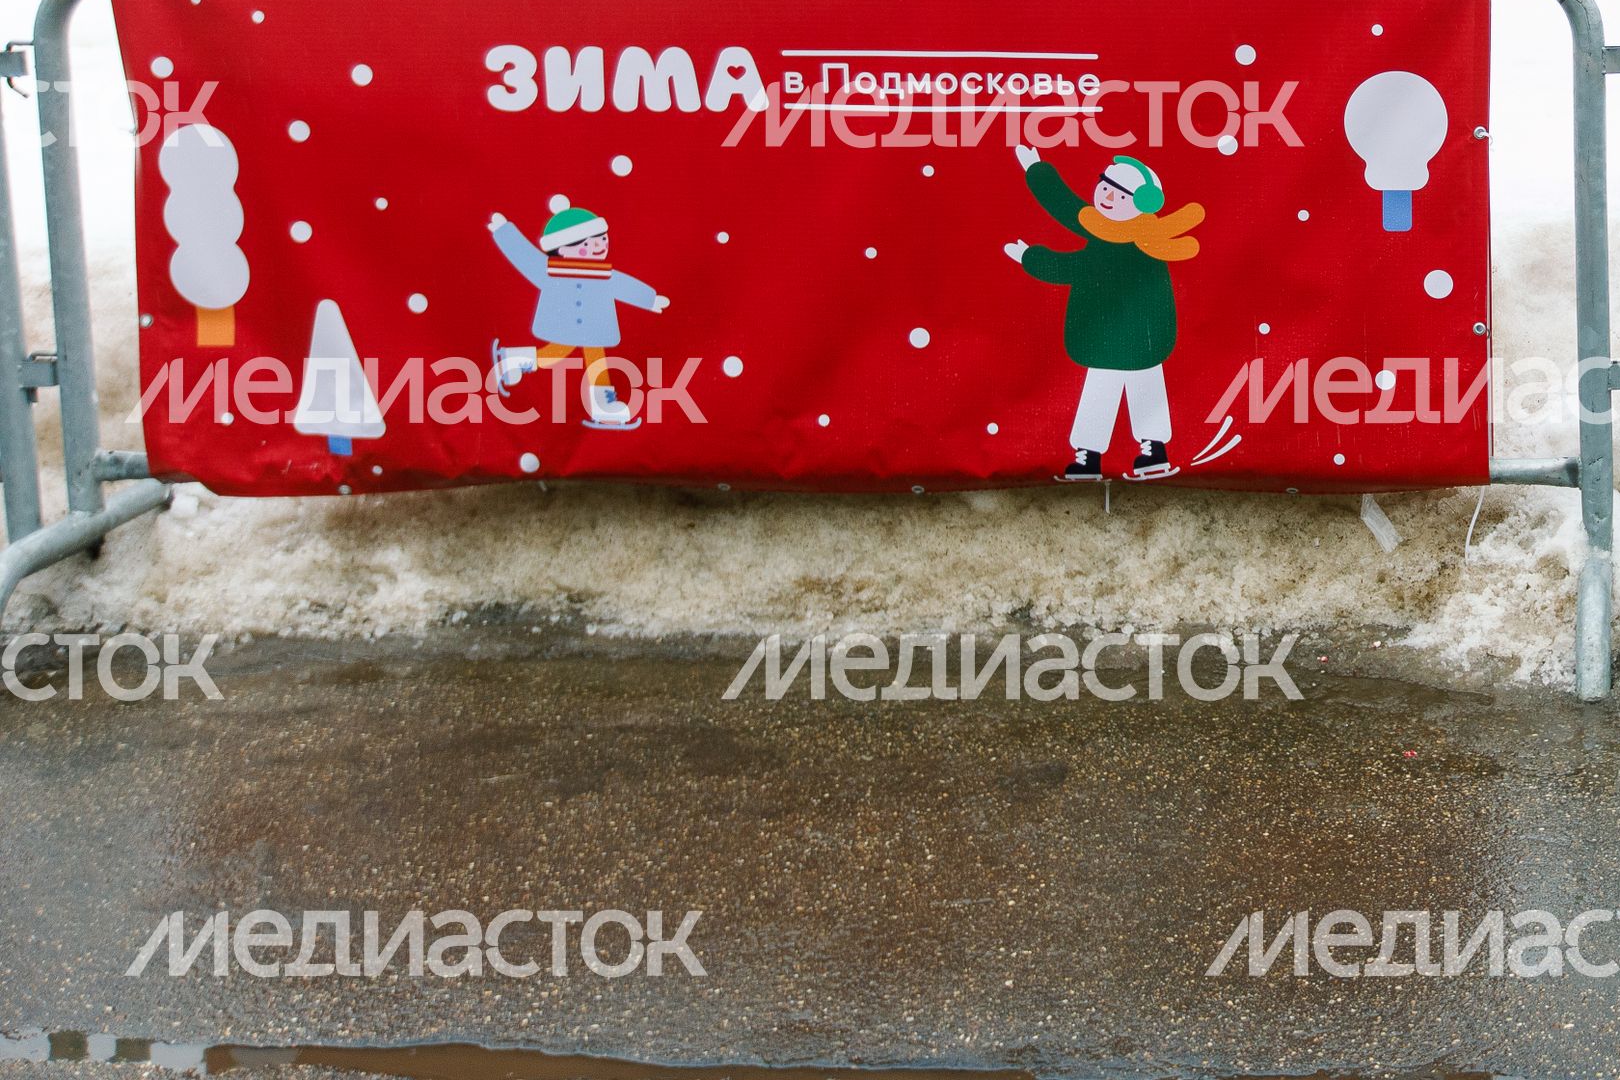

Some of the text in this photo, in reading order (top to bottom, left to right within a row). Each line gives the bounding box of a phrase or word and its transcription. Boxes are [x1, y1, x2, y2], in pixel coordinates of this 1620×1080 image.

[486, 44, 769, 112] ЗИМА
[785, 64, 1101, 100] в Подмосковье
